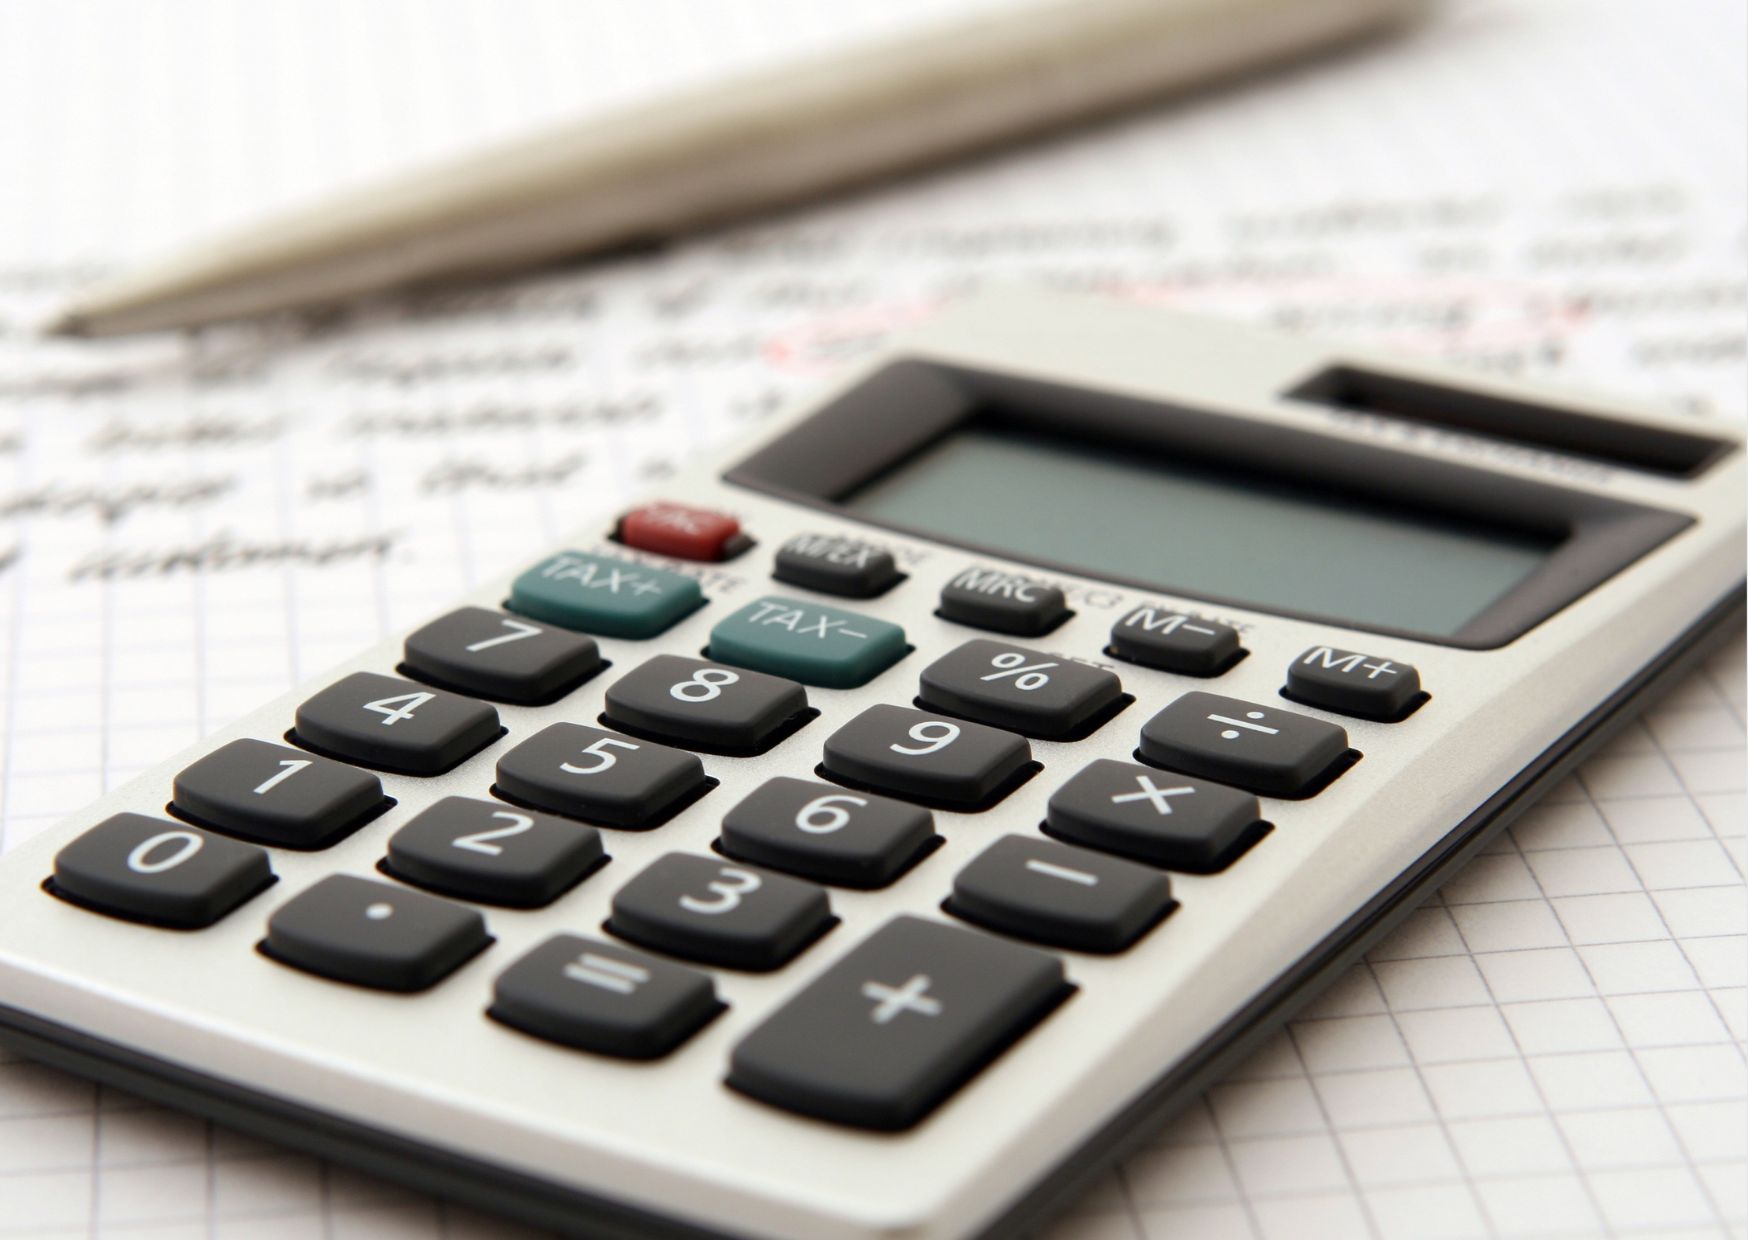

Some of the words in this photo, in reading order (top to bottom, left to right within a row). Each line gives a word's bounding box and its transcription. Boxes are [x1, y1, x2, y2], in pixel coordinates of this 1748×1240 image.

[954, 566, 1037, 602] MRC
[467, 619, 542, 652] 7
[980, 653, 1059, 691] %
[1303, 646, 1397, 679] M+
[669, 668, 740, 703] 8
[363, 691, 436, 726] 4
[559, 737, 640, 774] 5
[889, 721, 961, 756] 9
[253, 759, 313, 794] 1
[452, 811, 534, 855] 2
[795, 795, 868, 834] 6
[127, 831, 204, 873] 0
[679, 868, 761, 914] 3
[564, 952, 650, 994] =
[863, 974, 940, 1023] +
